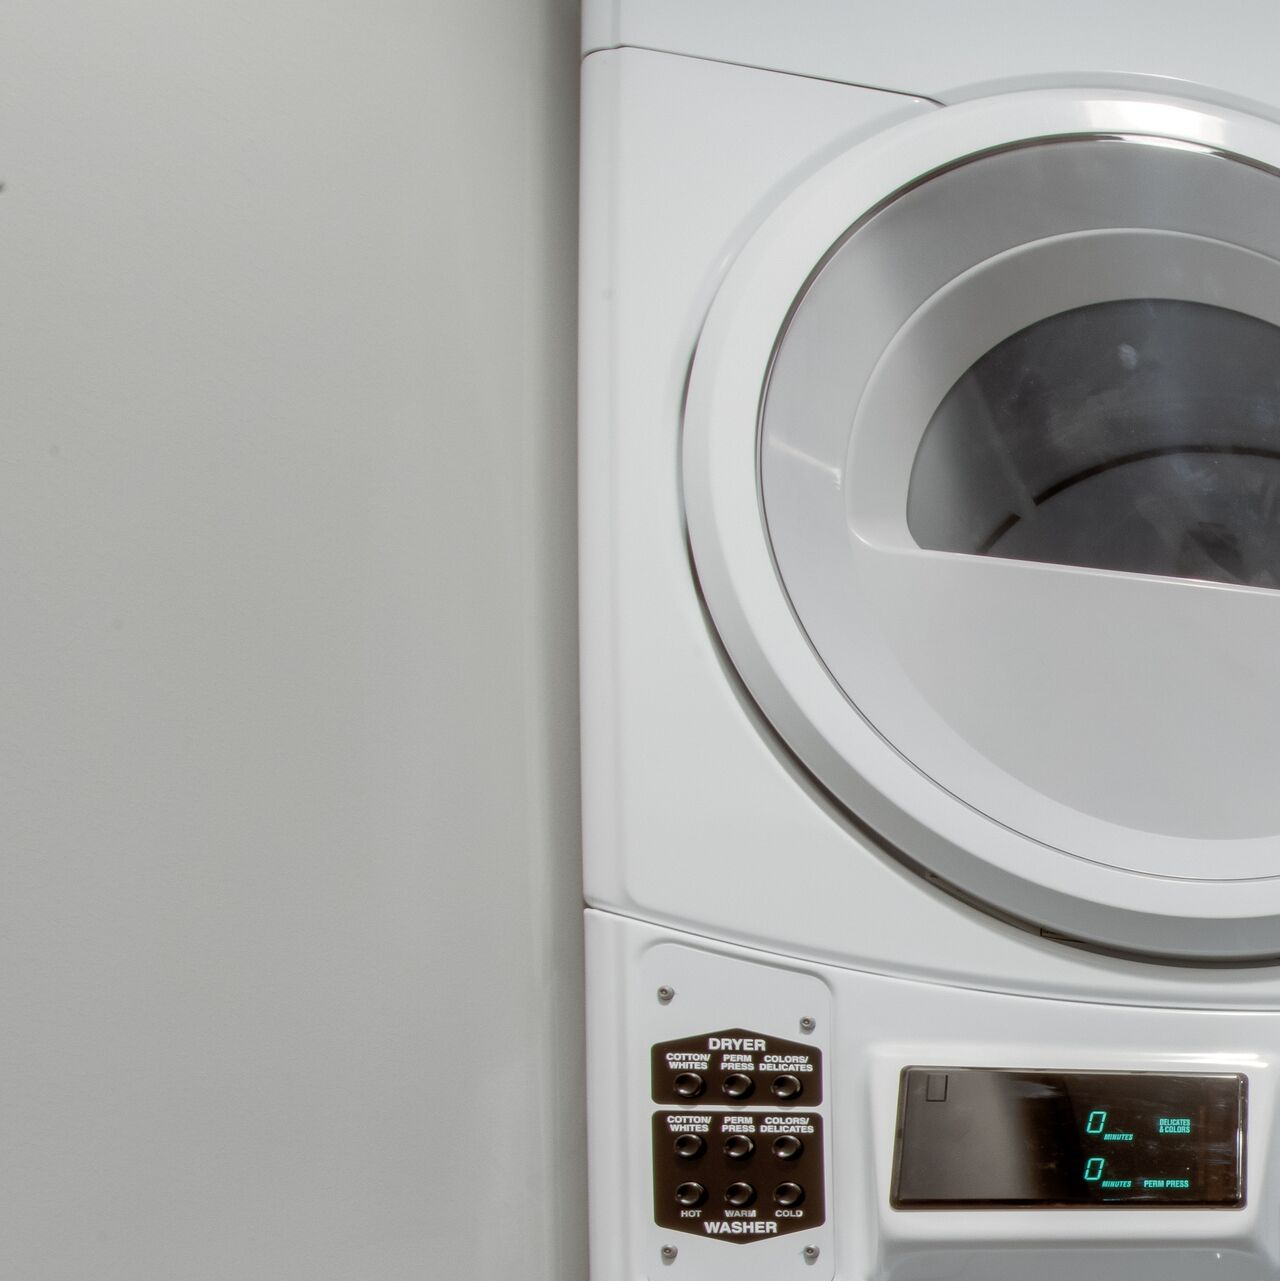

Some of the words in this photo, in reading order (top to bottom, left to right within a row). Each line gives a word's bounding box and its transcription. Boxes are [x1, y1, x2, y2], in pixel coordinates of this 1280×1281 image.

[708, 1038, 766, 1051] DRYER
[666, 1053, 711, 1062] COTTON/
[723, 1054, 752, 1063] PERM
[764, 1055, 809, 1064] COLORS/
[669, 1061, 708, 1070] WHITES
[720, 1063, 754, 1071] PRESS
[759, 1063, 813, 1072] DELICATES
[667, 1115, 712, 1124] COTTON/
[724, 1116, 753, 1125] PERM
[765, 1117, 810, 1125] COLORS/
[1086, 1111, 1107, 1134] 0
[670, 1124, 709, 1132] WHITES
[722, 1124, 755, 1133] PRESS
[760, 1125, 814, 1133] DELICATES
[1084, 1158, 1105, 1180] 0
[1143, 1180, 1164, 1188] PERM
[1166, 1180, 1189, 1188] PRESS
[681, 1210, 702, 1218] HOT
[775, 1209, 803, 1217] COLD
[704, 1221, 777, 1233] WASHER
